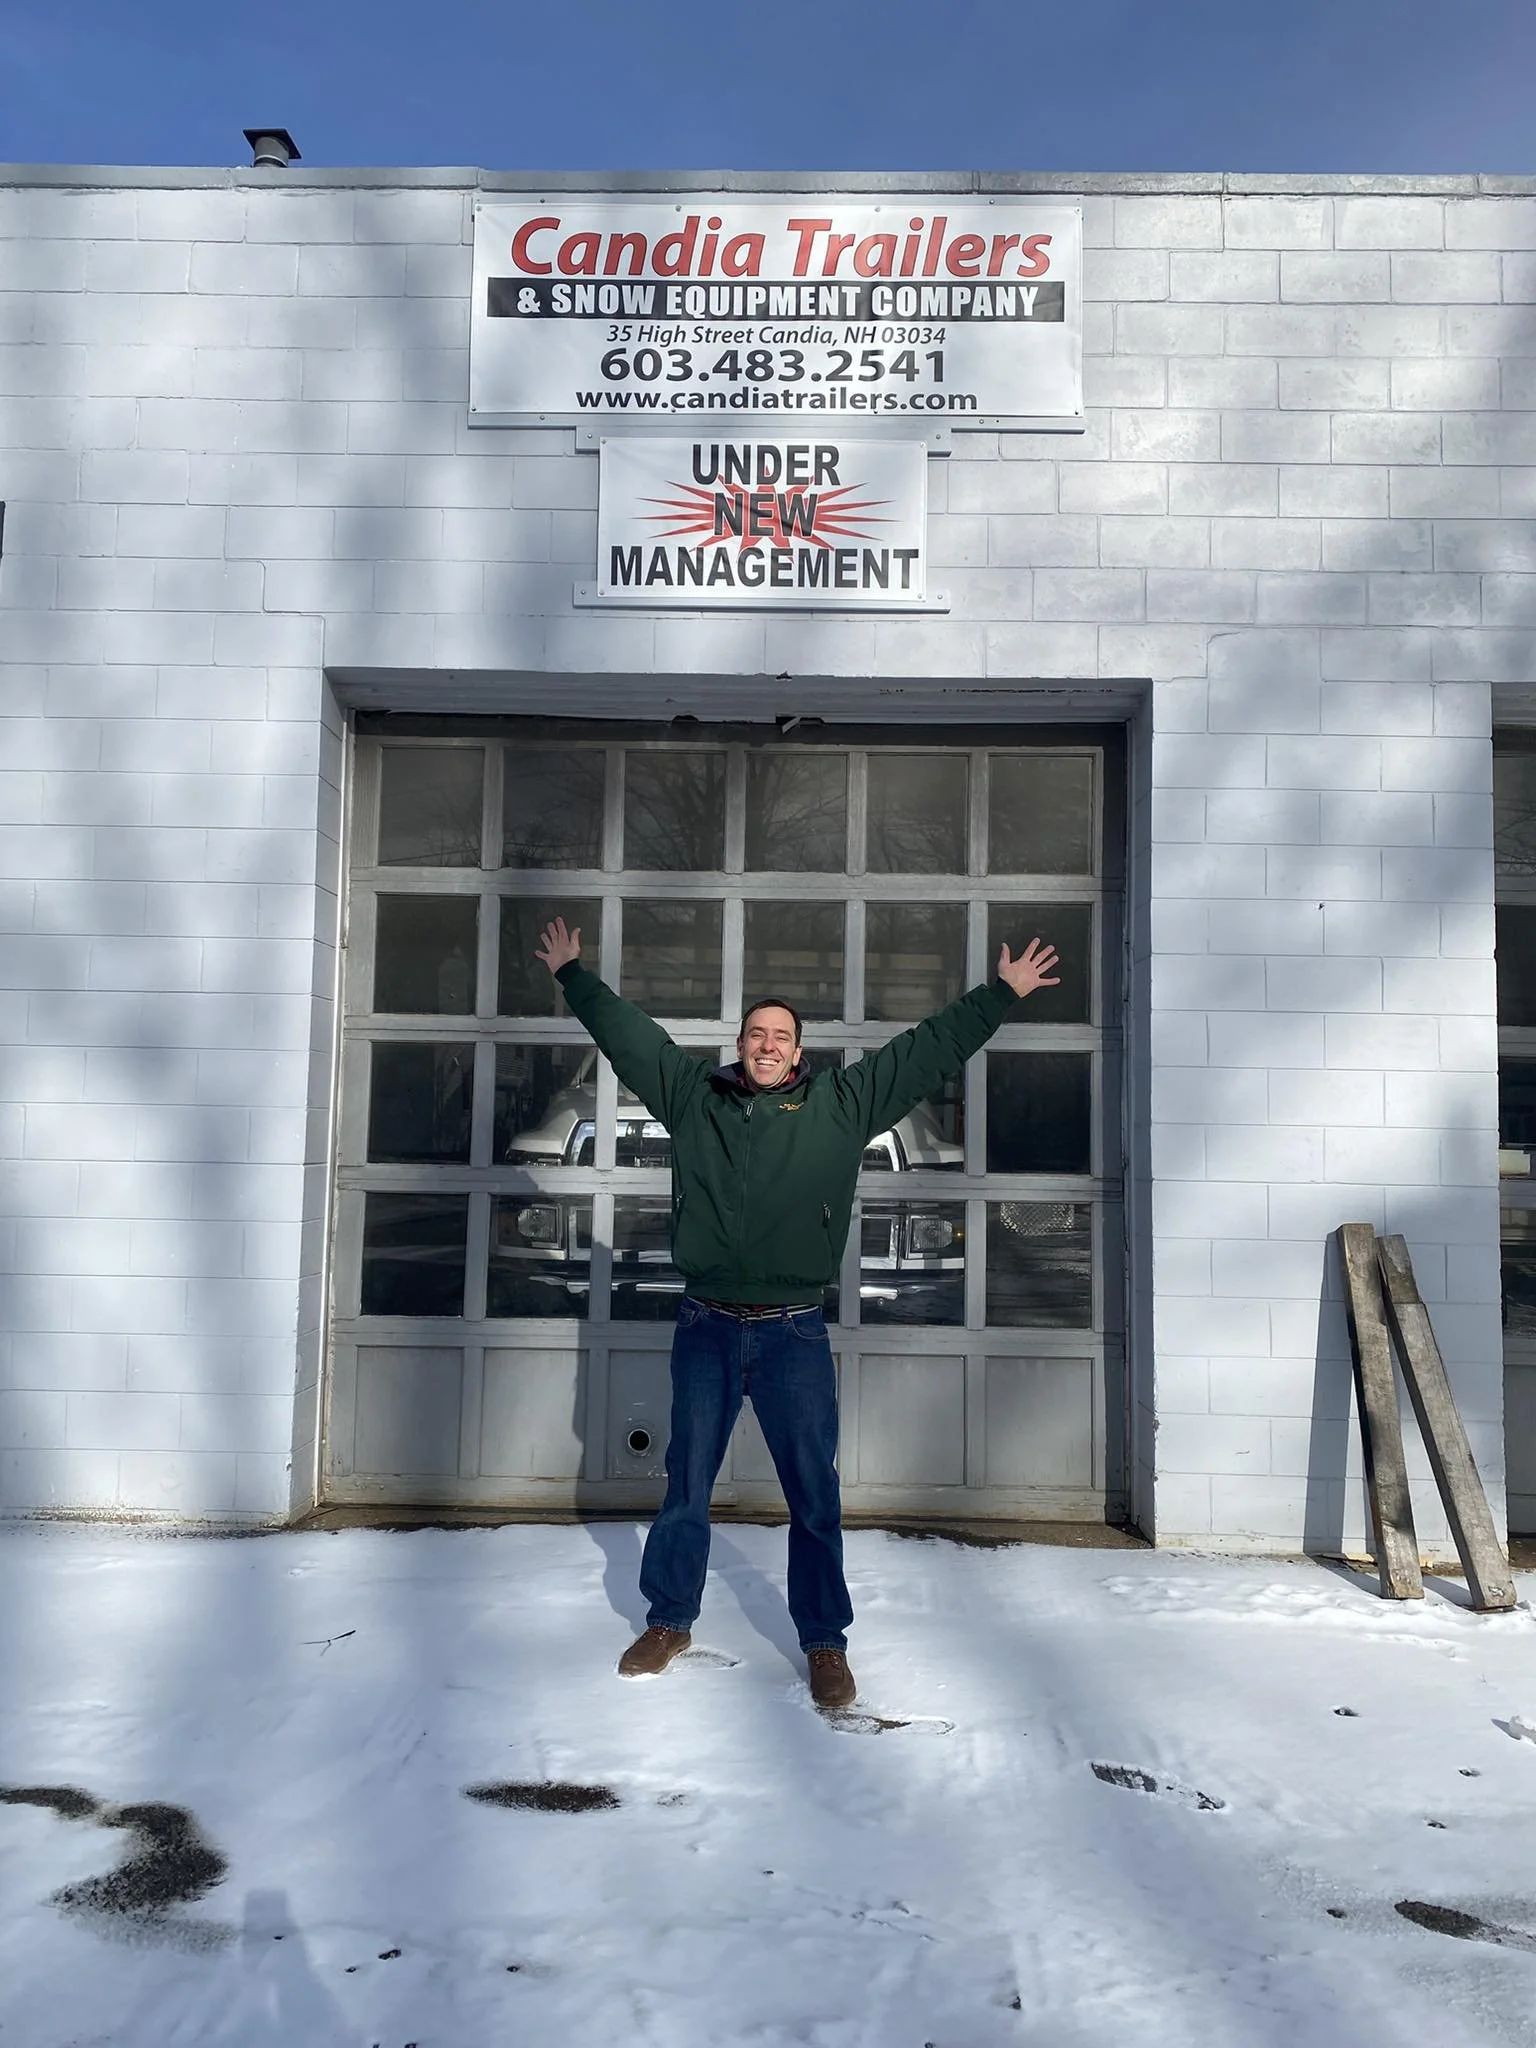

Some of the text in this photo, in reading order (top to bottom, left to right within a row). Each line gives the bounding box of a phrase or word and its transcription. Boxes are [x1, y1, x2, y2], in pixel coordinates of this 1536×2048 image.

[511, 215, 1053, 278] Candia Trailers
[517, 284, 1039, 319] & SNOW EQUIPMENT COMPANY
[606, 325, 946, 348] 35 High Street Candia, NH 03034
[600, 348, 946, 383] 603.483.2541
[576, 387, 978, 412] www.candiatrailers.com
[692, 444, 841, 486] UNDER
[713, 493, 818, 537] NEW
[610, 545, 919, 589] MANAGEMENT
